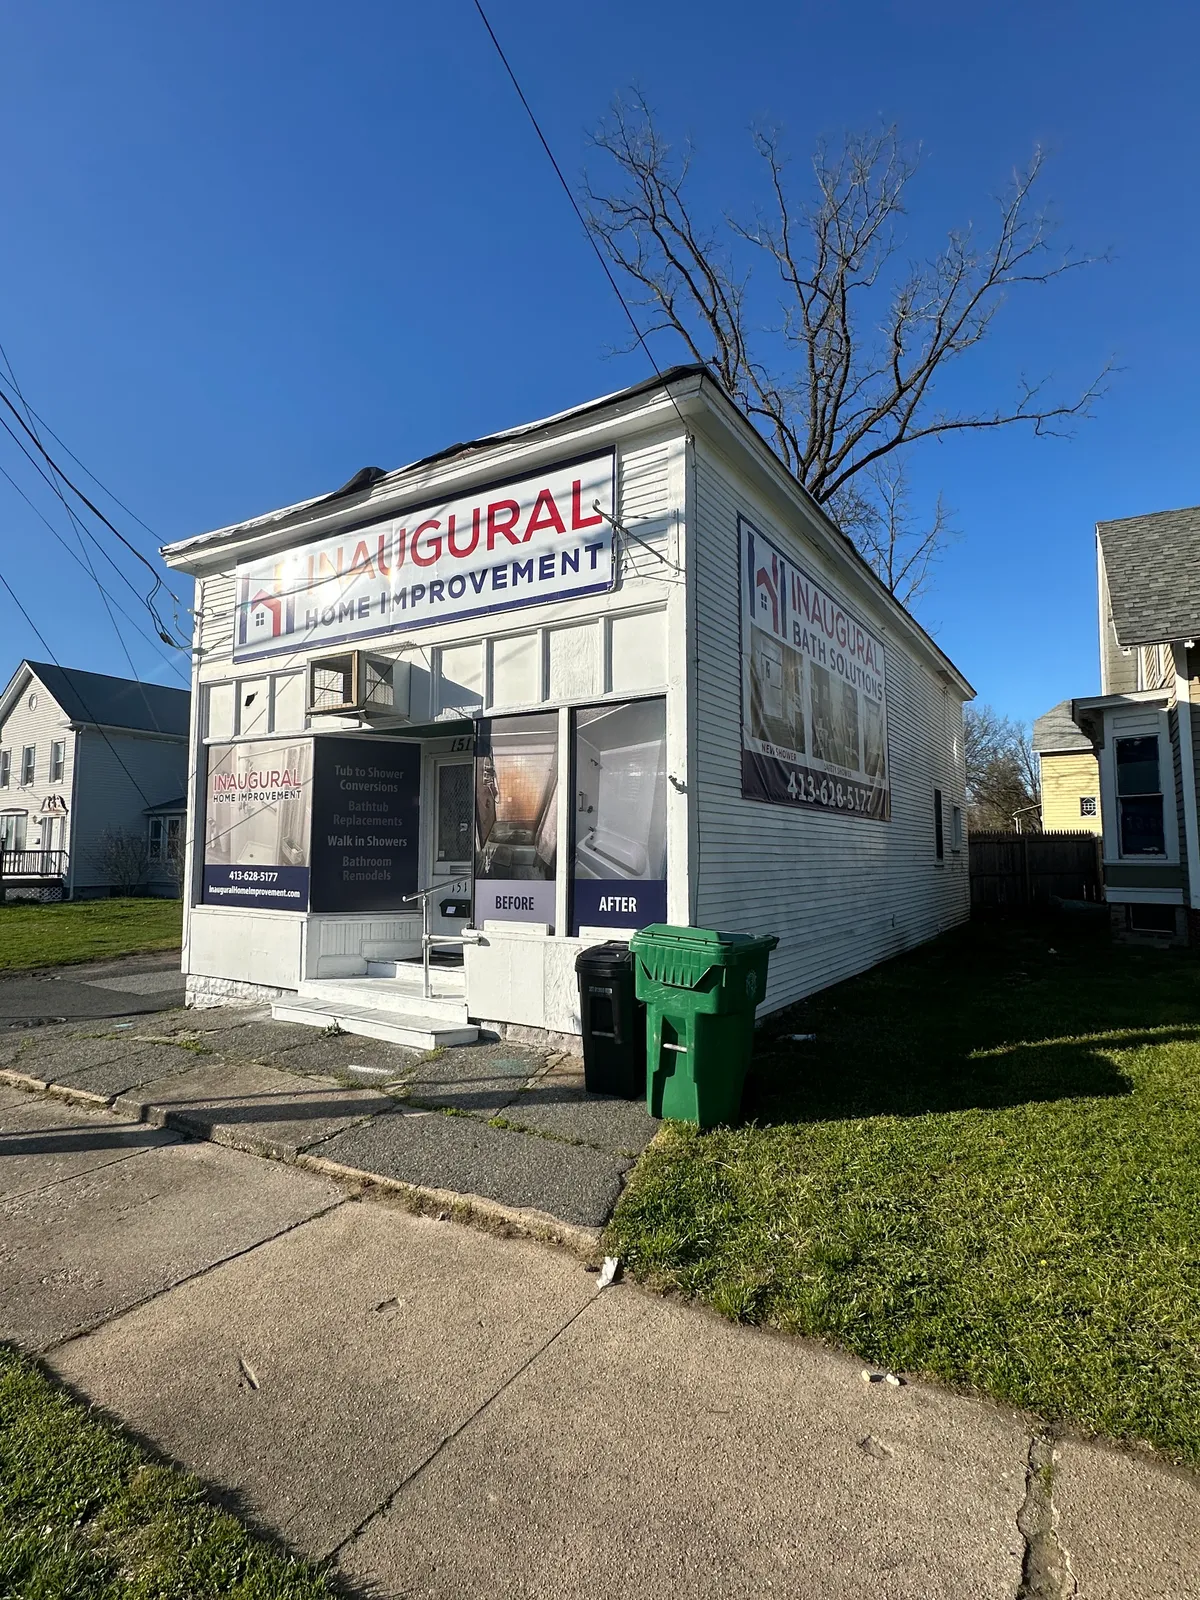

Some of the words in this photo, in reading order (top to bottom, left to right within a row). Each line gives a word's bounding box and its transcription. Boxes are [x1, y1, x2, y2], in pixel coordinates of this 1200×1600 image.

[307, 480, 602, 595] INAUGURAL
[305, 596, 370, 630] HOME
[381, 542, 604, 614] IMPROVEMENT
[791, 571, 881, 676] INAUGURAL
[793, 620, 826, 664] BATH
[829, 648, 882, 701] SOLUTIONS
[450, 736, 471, 752] 151
[761, 743, 775, 756] NEW
[775, 747, 797, 761] SHOWER
[335, 765, 353, 776] Tub
[355, 767, 366, 777] to
[368, 767, 404, 779] Shower
[214, 769, 301, 791] INAUGURAL
[340, 780, 398, 792] Conversions
[213, 794, 236, 802] HOME
[238, 790, 301, 802] IMPROVEMENT
[787, 771, 873, 814] 413-628-5177
[348, 800, 389, 812] Bathtub
[333, 814, 403, 827] Replacements
[327, 835, 353, 847] Walk
[355, 835, 365, 847] in
[366, 836, 407, 847] Showers
[342, 856, 392, 867] Bathroom
[228, 871, 278, 882] 413-628-5177
[342, 870, 391, 881] Remodels
[451, 881, 467, 893] 151
[495, 895, 535, 911] BEFORE
[598, 896, 637, 912] AFTER
